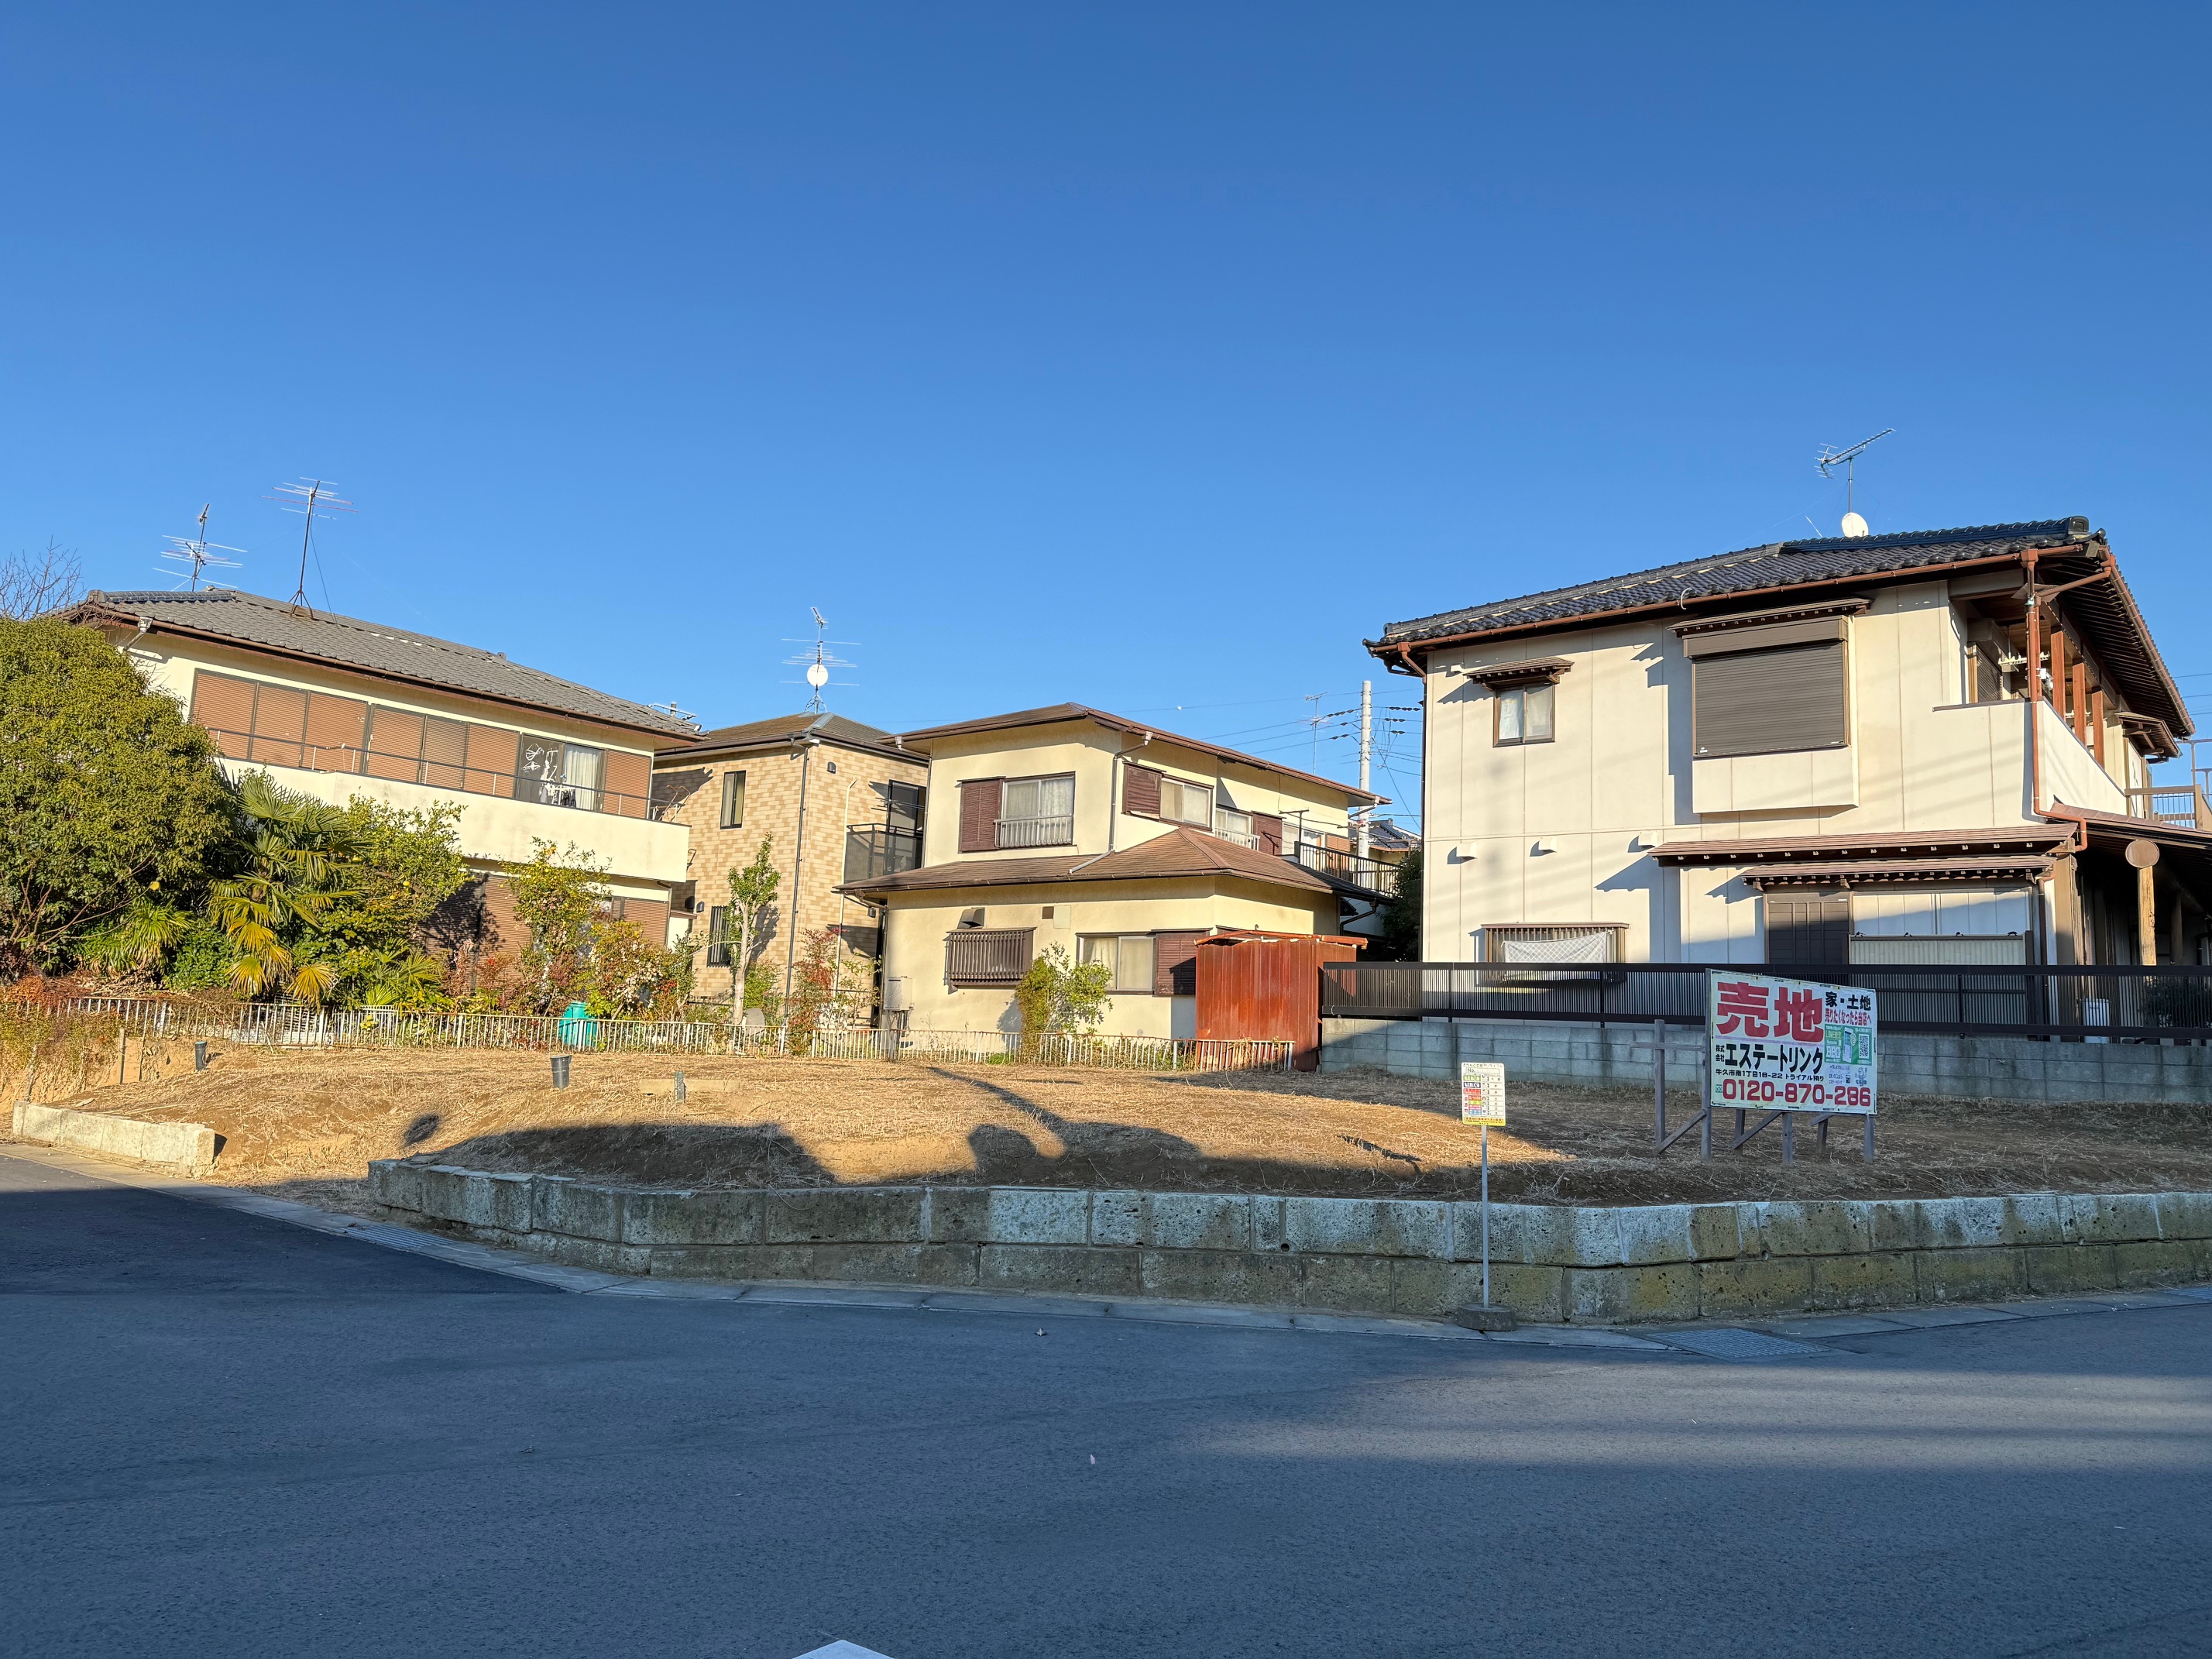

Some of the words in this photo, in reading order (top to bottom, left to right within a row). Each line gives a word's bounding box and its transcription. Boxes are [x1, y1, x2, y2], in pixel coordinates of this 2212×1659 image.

[1825, 991, 1871, 1012] 家・土地
[1716, 981, 1824, 1042] 売地
[1825, 1008, 1872, 1026] 売りたくなったら当店へ
[1716, 1044, 1725, 1053] 株式
[1716, 1054, 1725, 1063] 会社
[1725, 1043, 1823, 1075] エステートリンク
[1716, 1069, 1783, 1079] 牛久市南1丁目18-22
[1723, 1078, 1871, 1107] 0120-870-286
